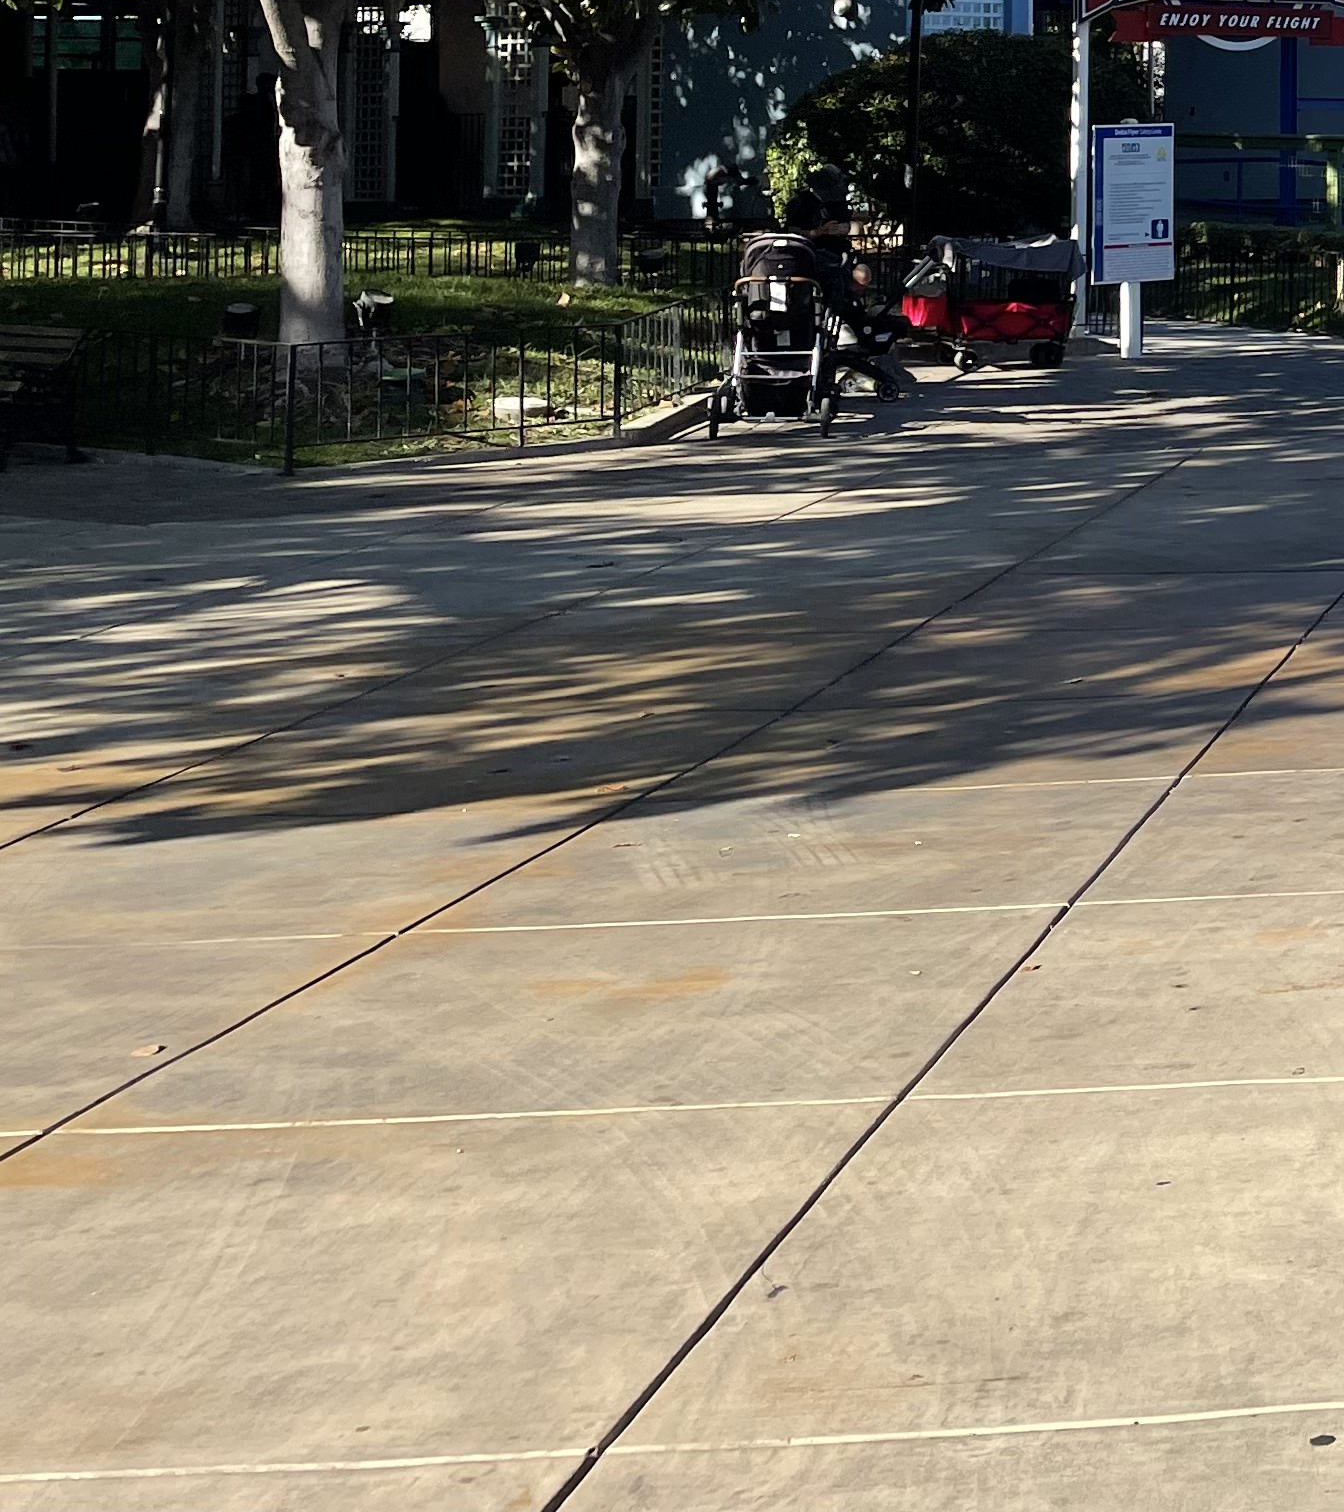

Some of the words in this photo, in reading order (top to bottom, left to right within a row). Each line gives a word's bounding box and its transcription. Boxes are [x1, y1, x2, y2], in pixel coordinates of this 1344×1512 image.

[1159, 13, 1210, 27] ENJOY
[1218, 14, 1260, 29] YOUR
[1266, 16, 1321, 30] FLIGHT
